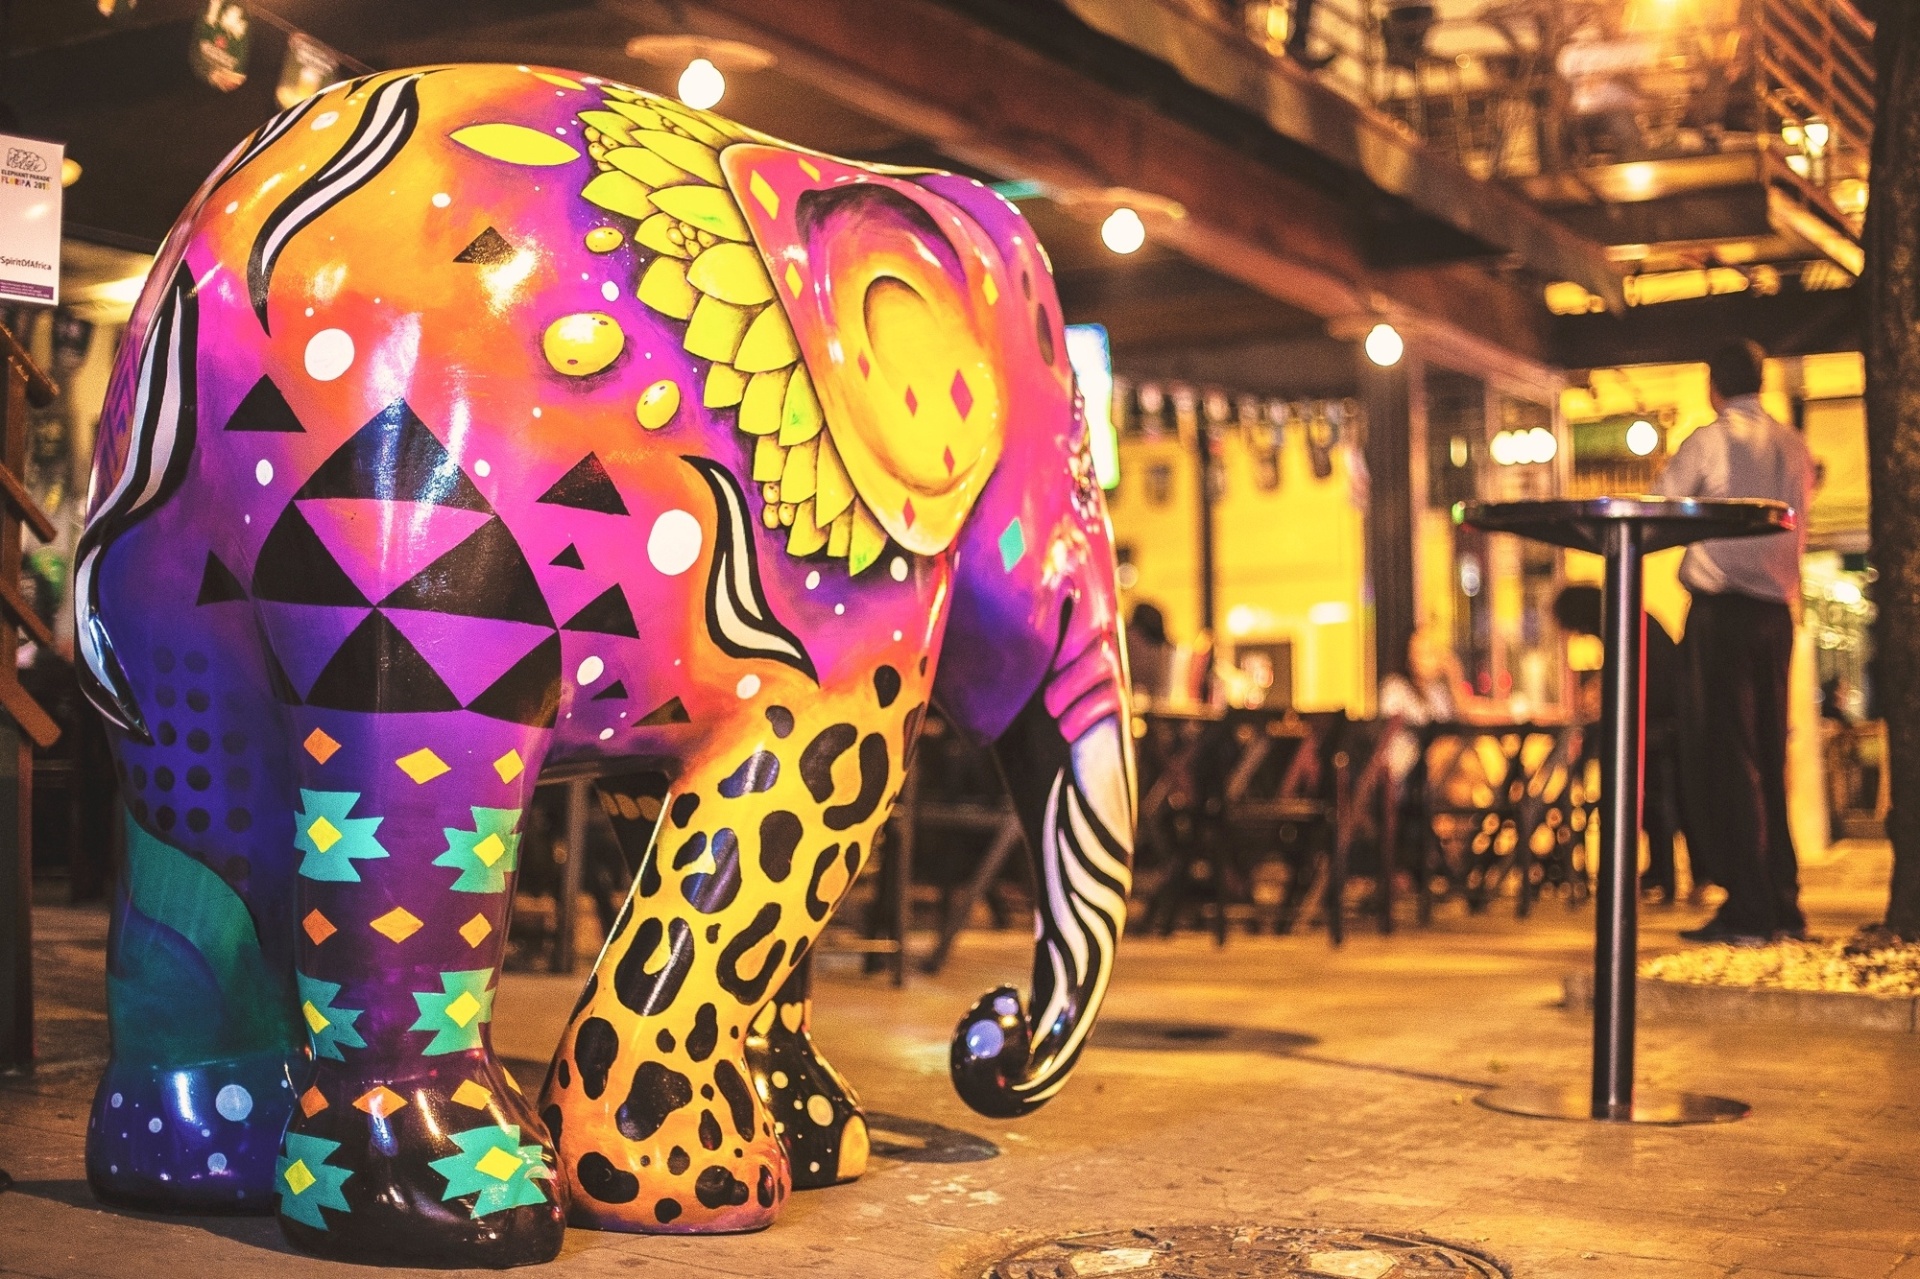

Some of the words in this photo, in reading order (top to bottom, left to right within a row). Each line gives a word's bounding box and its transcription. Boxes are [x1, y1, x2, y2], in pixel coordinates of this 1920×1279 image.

[1, 169, 28, 179] ELEPHANT
[29, 173, 50, 182] PARADE
[1, 175, 31, 188] FLORIPA
[0, 256, 52, 270] SpiritOfAfrica
